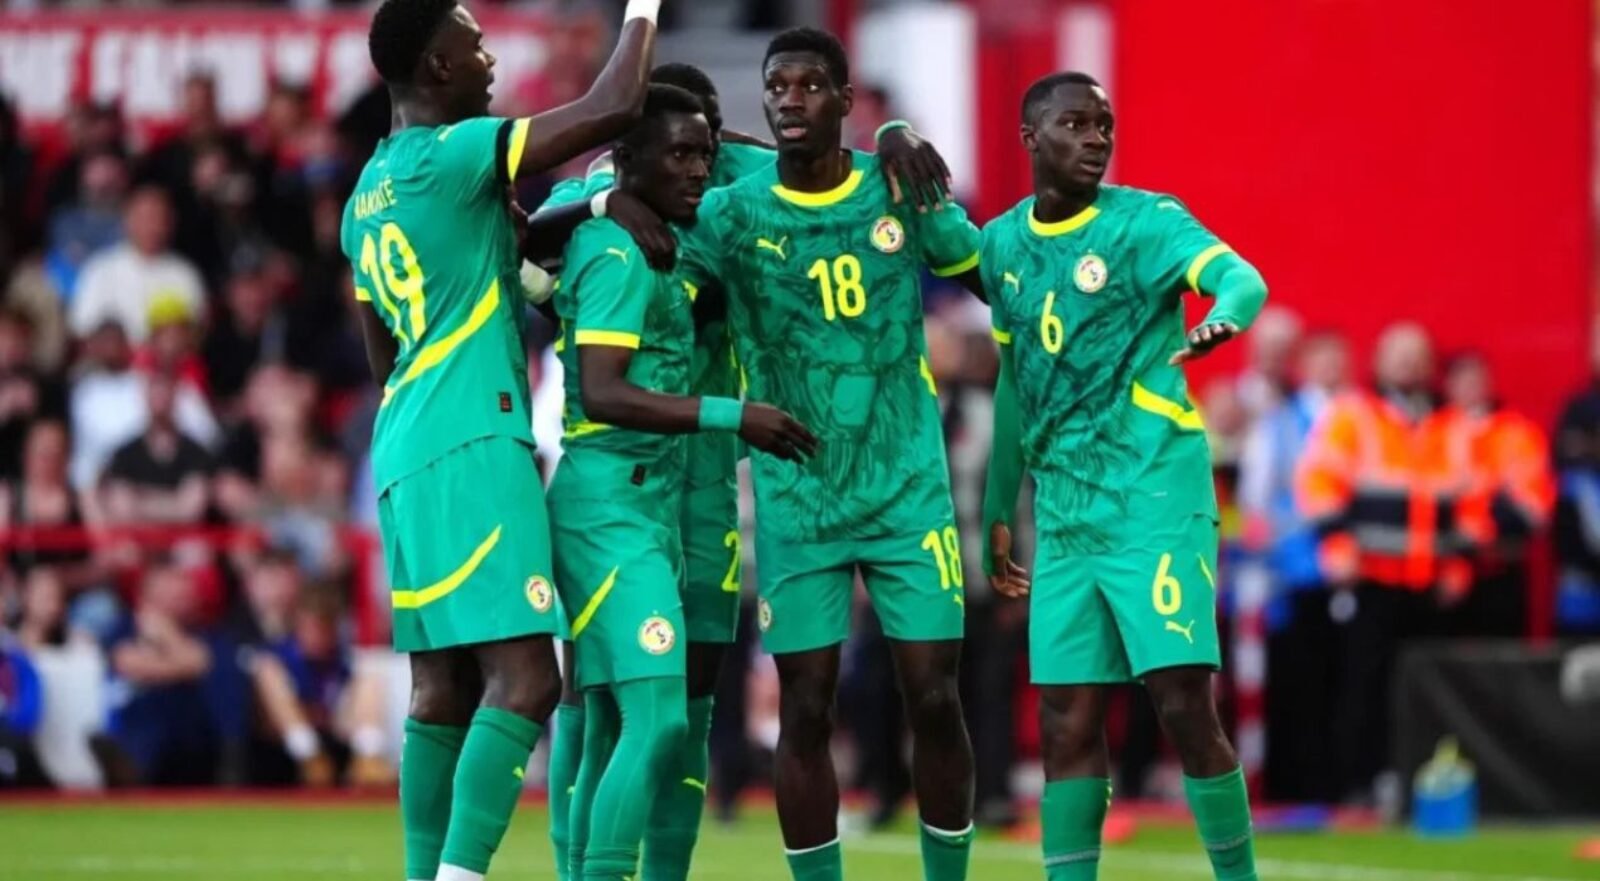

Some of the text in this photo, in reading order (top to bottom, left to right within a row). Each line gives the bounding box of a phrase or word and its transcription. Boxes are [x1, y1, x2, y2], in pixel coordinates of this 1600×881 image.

[360, 222, 427, 357] 19
[807, 254, 867, 321] 18
[1041, 291, 1064, 353] 6
[721, 530, 741, 592] 2
[921, 525, 964, 590] 18
[1152, 552, 1182, 616] 6
